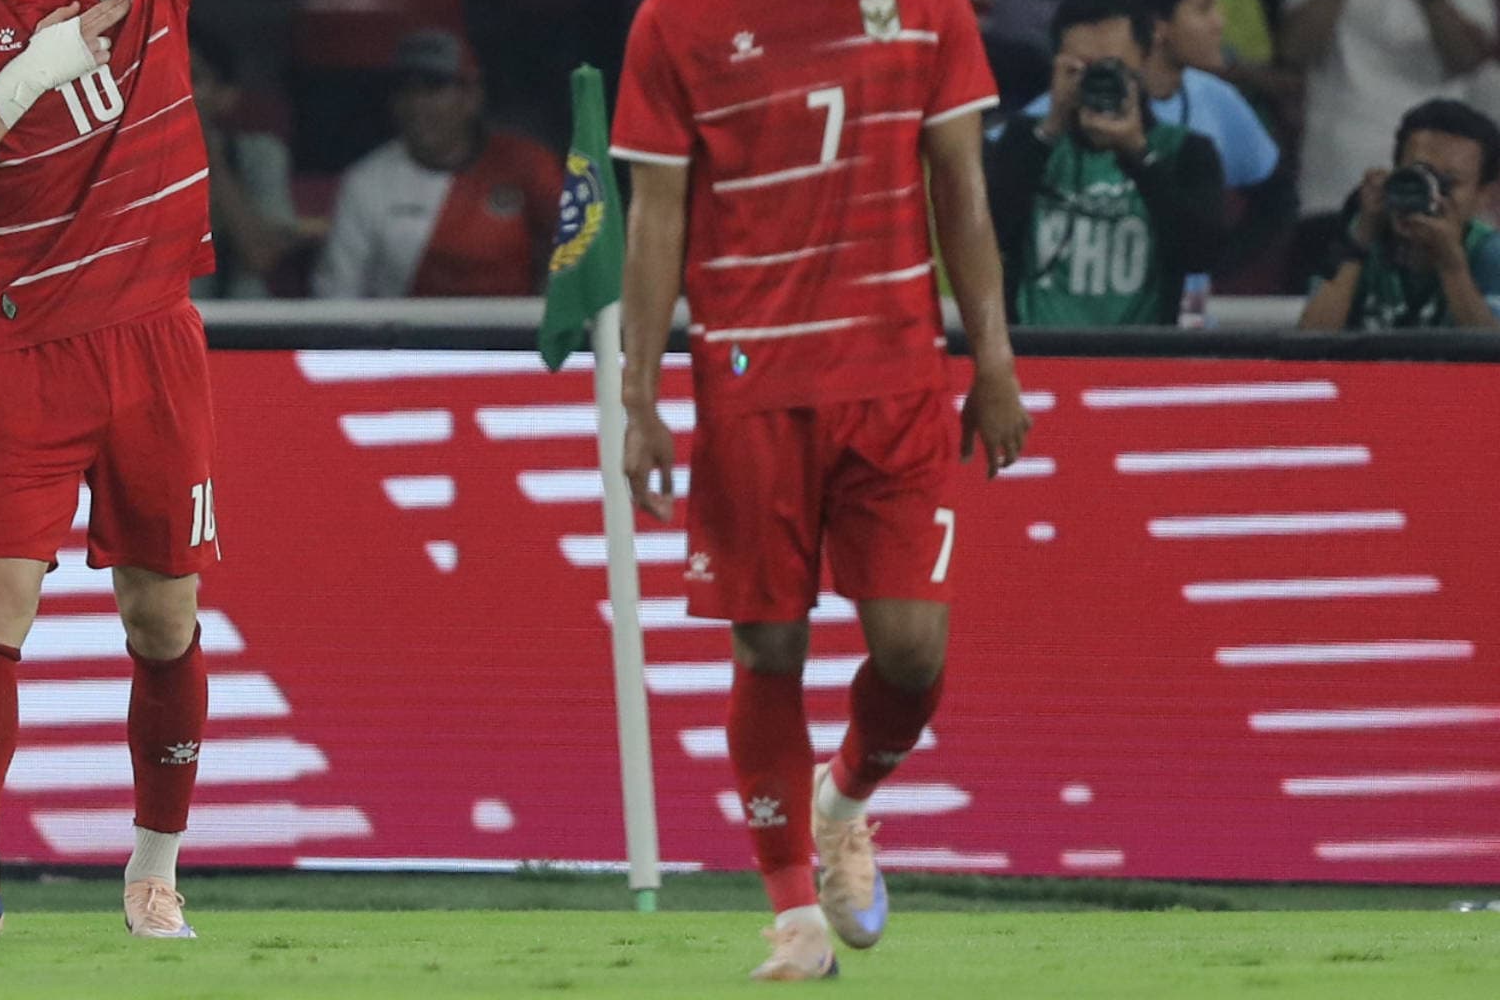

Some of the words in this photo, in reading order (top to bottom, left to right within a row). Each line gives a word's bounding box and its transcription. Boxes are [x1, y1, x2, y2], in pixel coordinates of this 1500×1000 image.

[54, 63, 125, 135] 10
[806, 86, 846, 168] 7
[930, 506, 956, 583] 7
